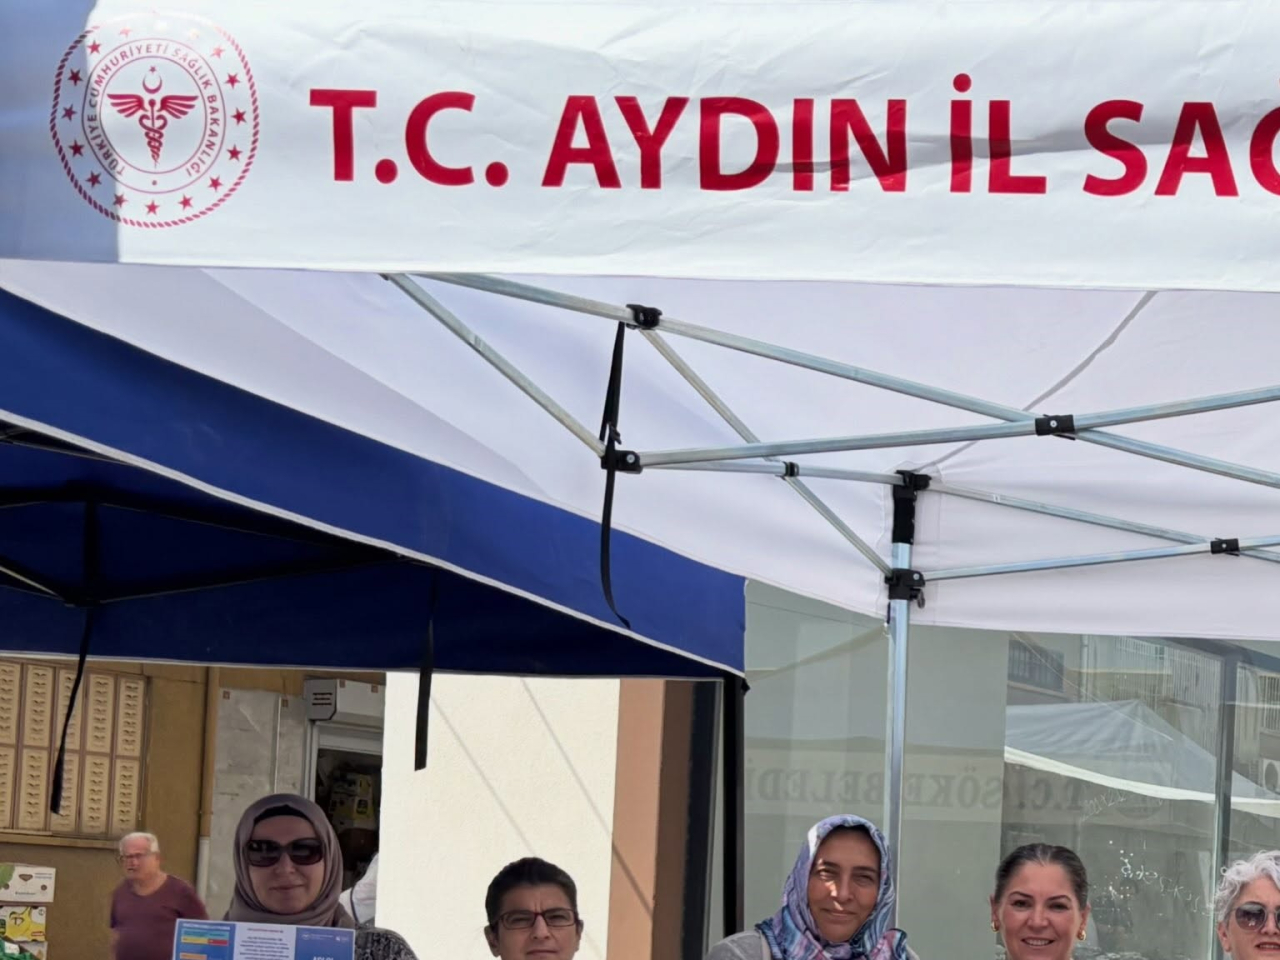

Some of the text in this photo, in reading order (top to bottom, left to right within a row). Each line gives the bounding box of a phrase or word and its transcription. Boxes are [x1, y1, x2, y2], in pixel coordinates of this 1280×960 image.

[186, 94, 220, 178] BAKANLIĞI
[310, 89, 509, 187] T.C.
[541, 95, 908, 192] AYDIN
[949, 73, 1047, 195] İL
